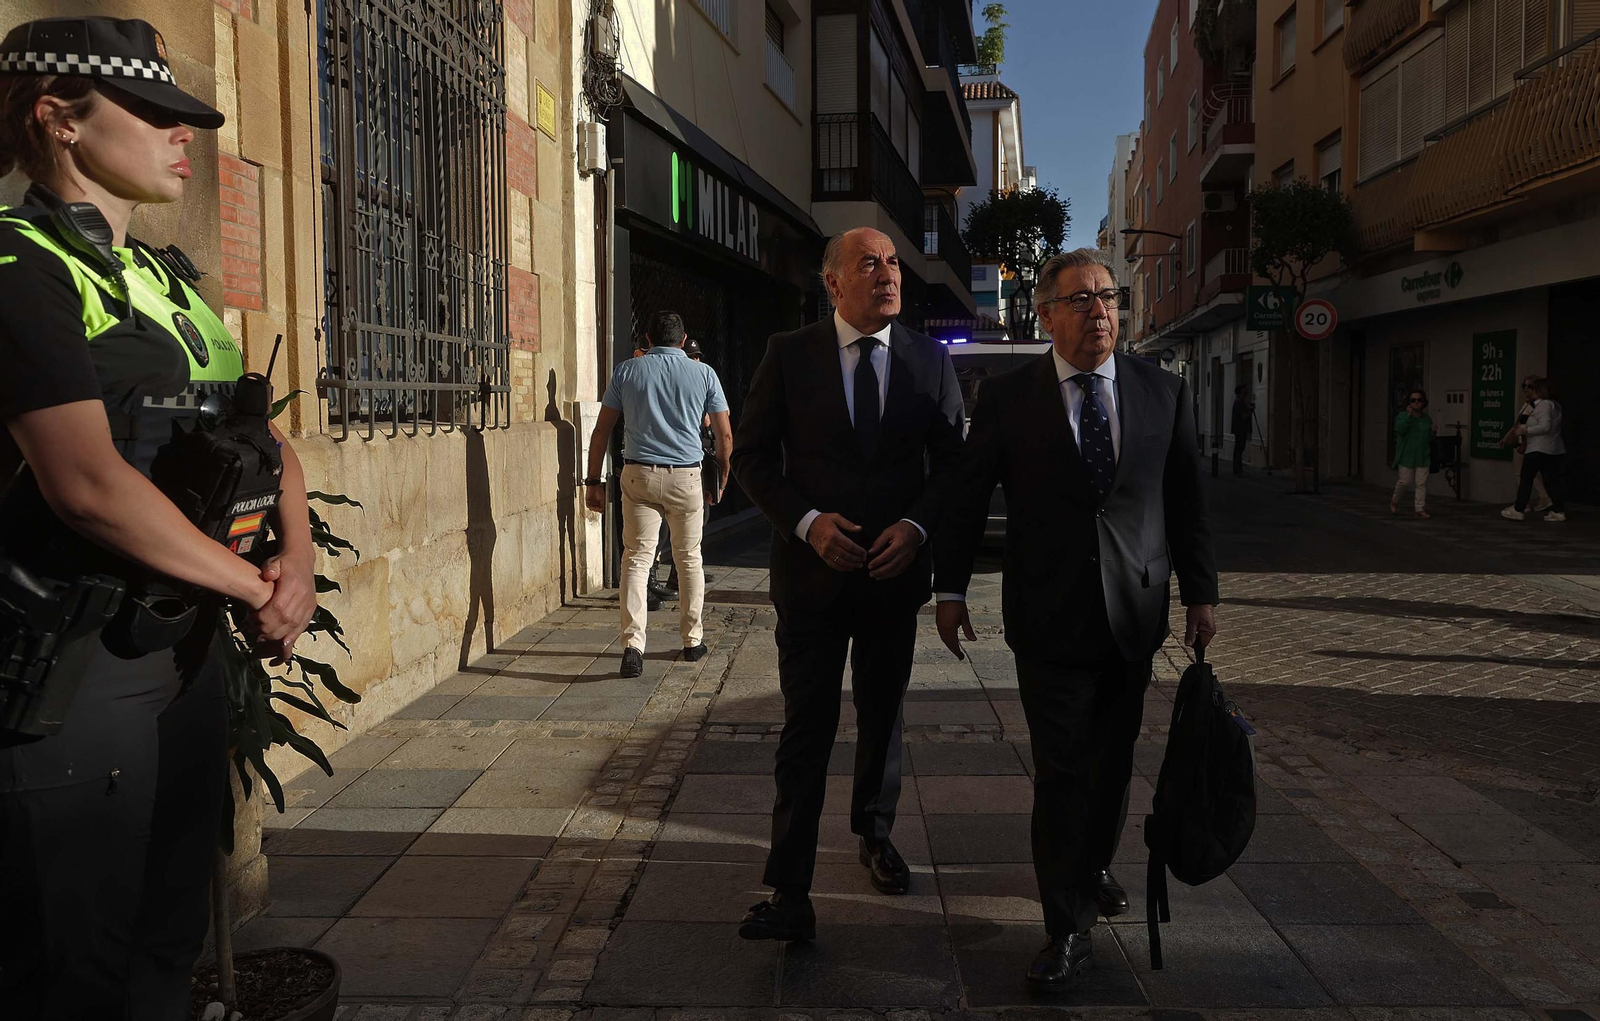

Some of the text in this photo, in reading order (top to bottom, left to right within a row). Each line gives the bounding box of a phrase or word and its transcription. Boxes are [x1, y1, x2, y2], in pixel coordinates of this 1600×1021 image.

[698, 167, 760, 262] MILAR
[1401, 270, 1443, 292] Carrefour
[1305, 313, 1327, 325] 20
[1482, 341, 1503, 360] 9h a
[1481, 363, 1502, 381] 22h
